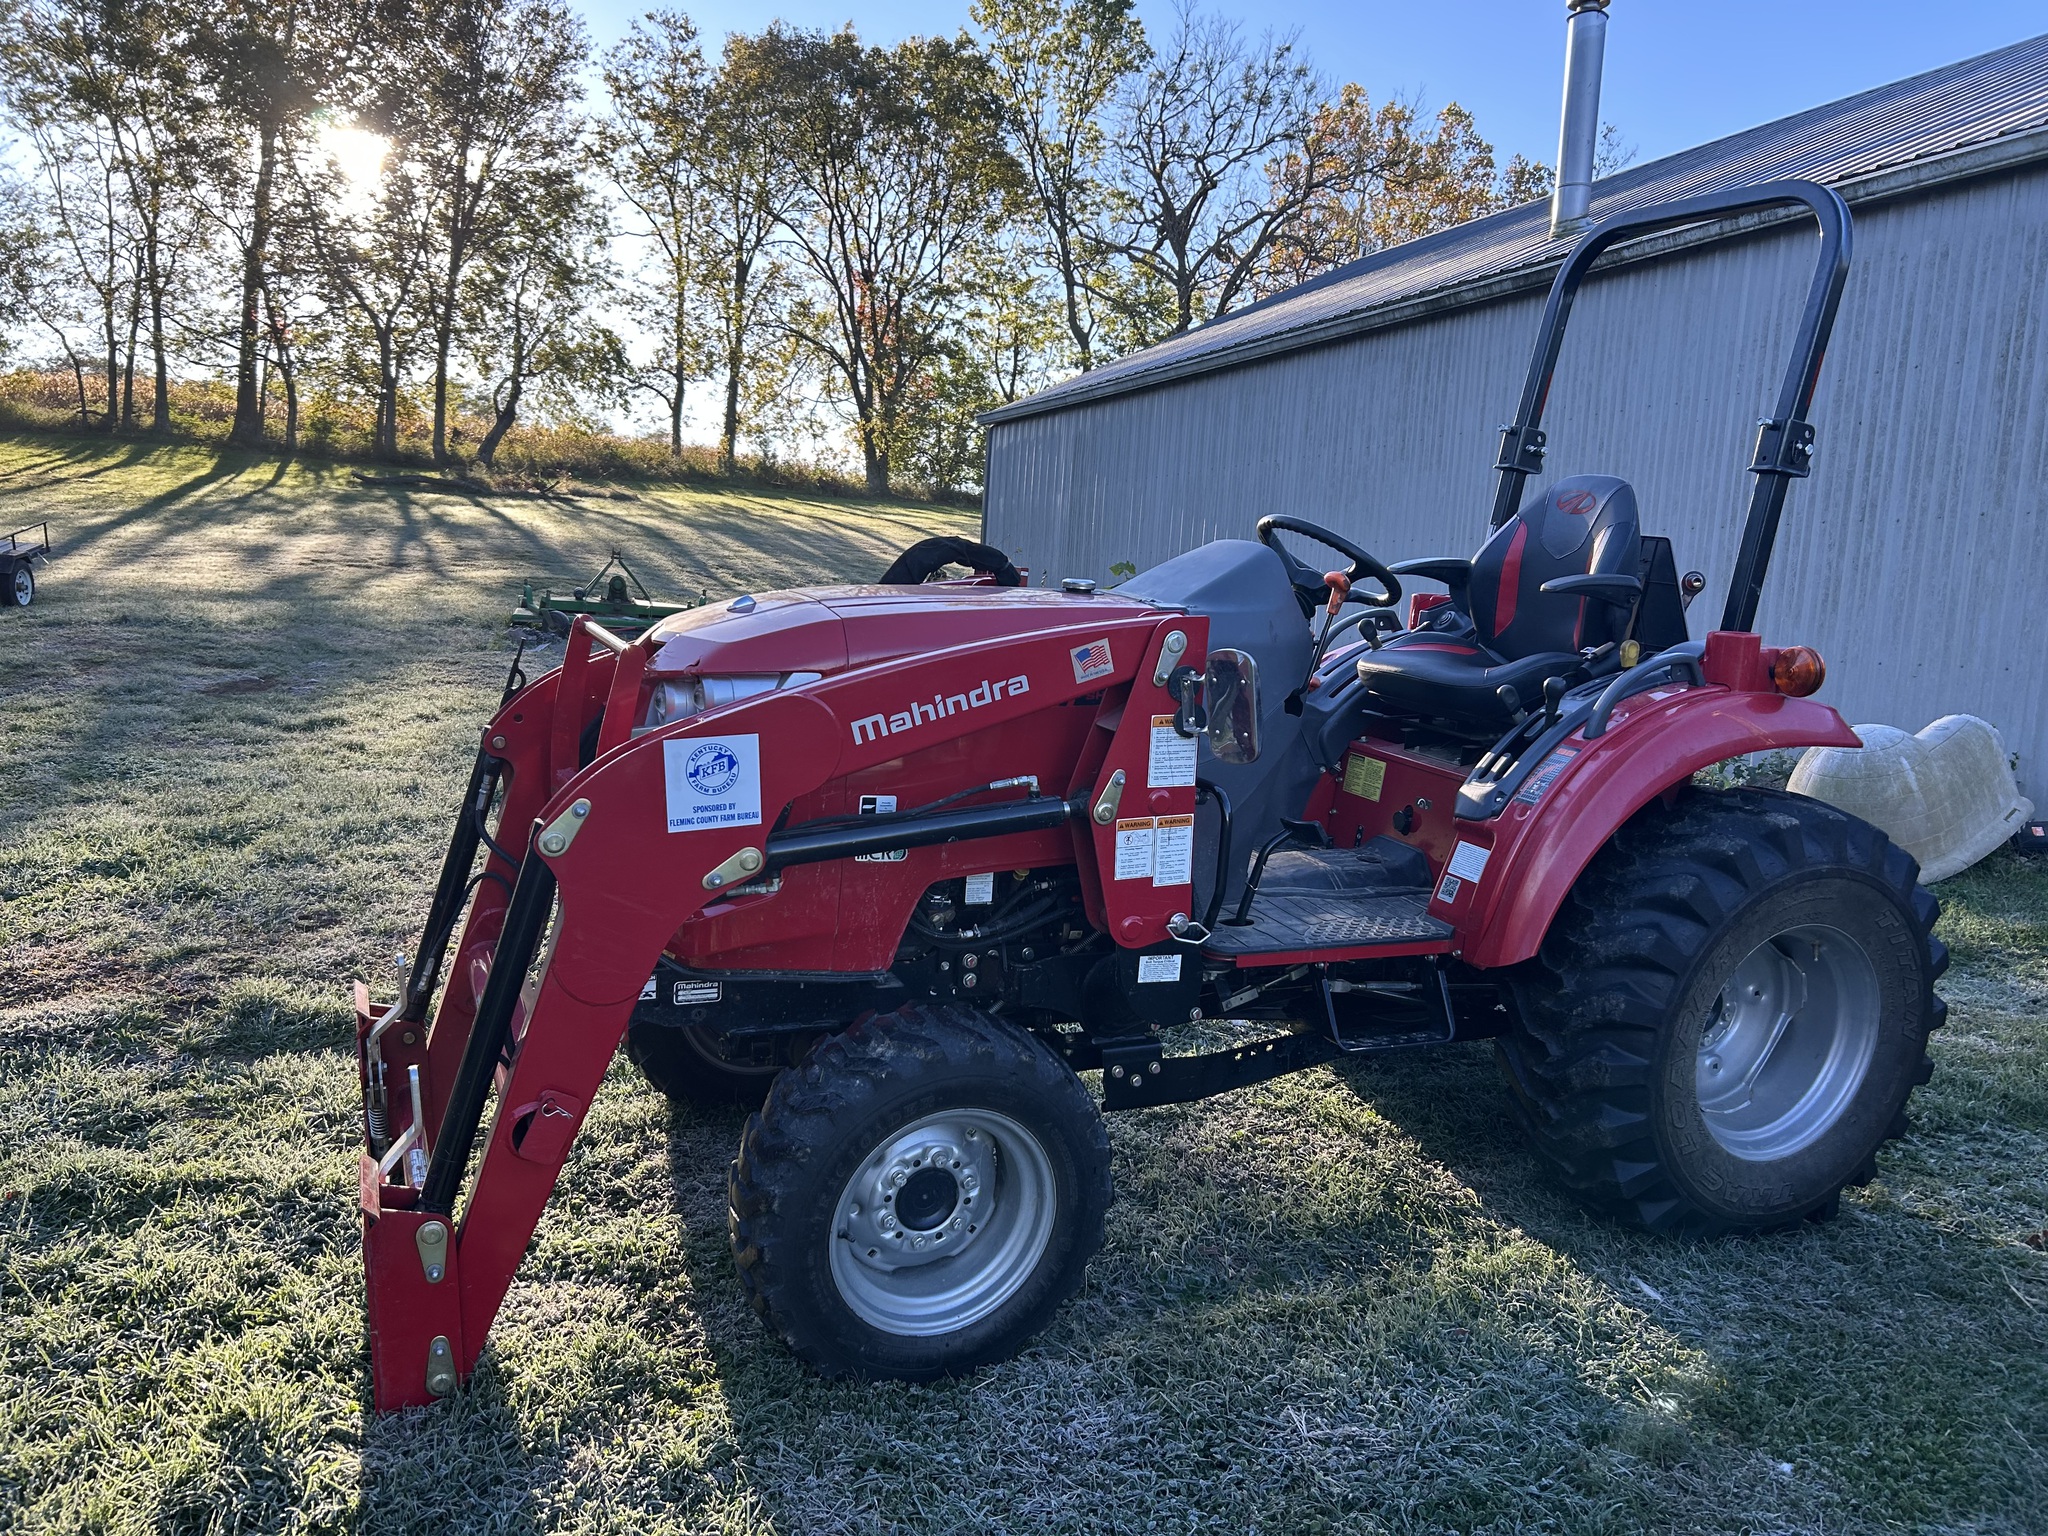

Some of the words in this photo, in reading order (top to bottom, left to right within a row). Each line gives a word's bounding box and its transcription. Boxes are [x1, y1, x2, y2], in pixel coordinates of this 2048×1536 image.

[851, 674, 1029, 745] Mahindra
[691, 745, 729, 762] KENTUCKY
[701, 760, 725, 778] KFB
[691, 779, 710, 793] FARM
[712, 772, 737, 794] BUREAU
[692, 803, 727, 814] SPONSORED
[728, 802, 736, 810] BY
[669, 816, 695, 827] FLEMING
[696, 815, 720, 825] COUNTY
[720, 813, 736, 822] FARM
[737, 811, 759, 820] BUREAU
[1124, 820, 1151, 829] WARNING
[1164, 817, 1190, 825] WARNING
[1874, 908, 1921, 1041] TITAN
